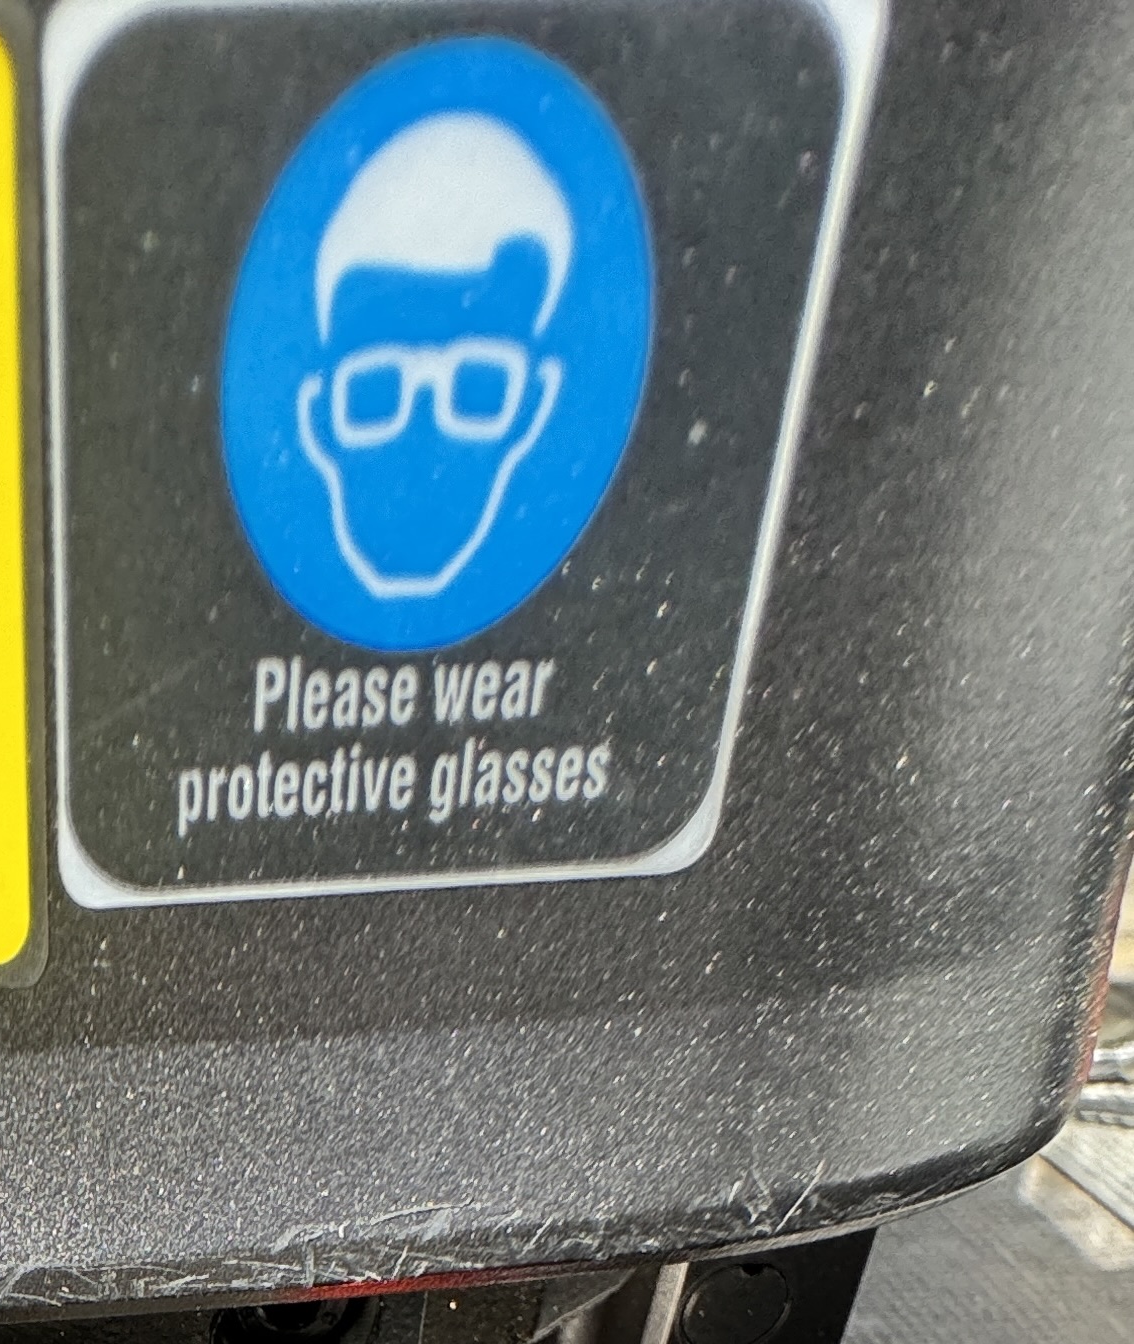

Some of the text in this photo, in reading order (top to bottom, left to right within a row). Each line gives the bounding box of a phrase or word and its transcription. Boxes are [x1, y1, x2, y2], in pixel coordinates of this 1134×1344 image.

[252, 655, 558, 733] Please wear
[177, 737, 612, 837] protective glasses
